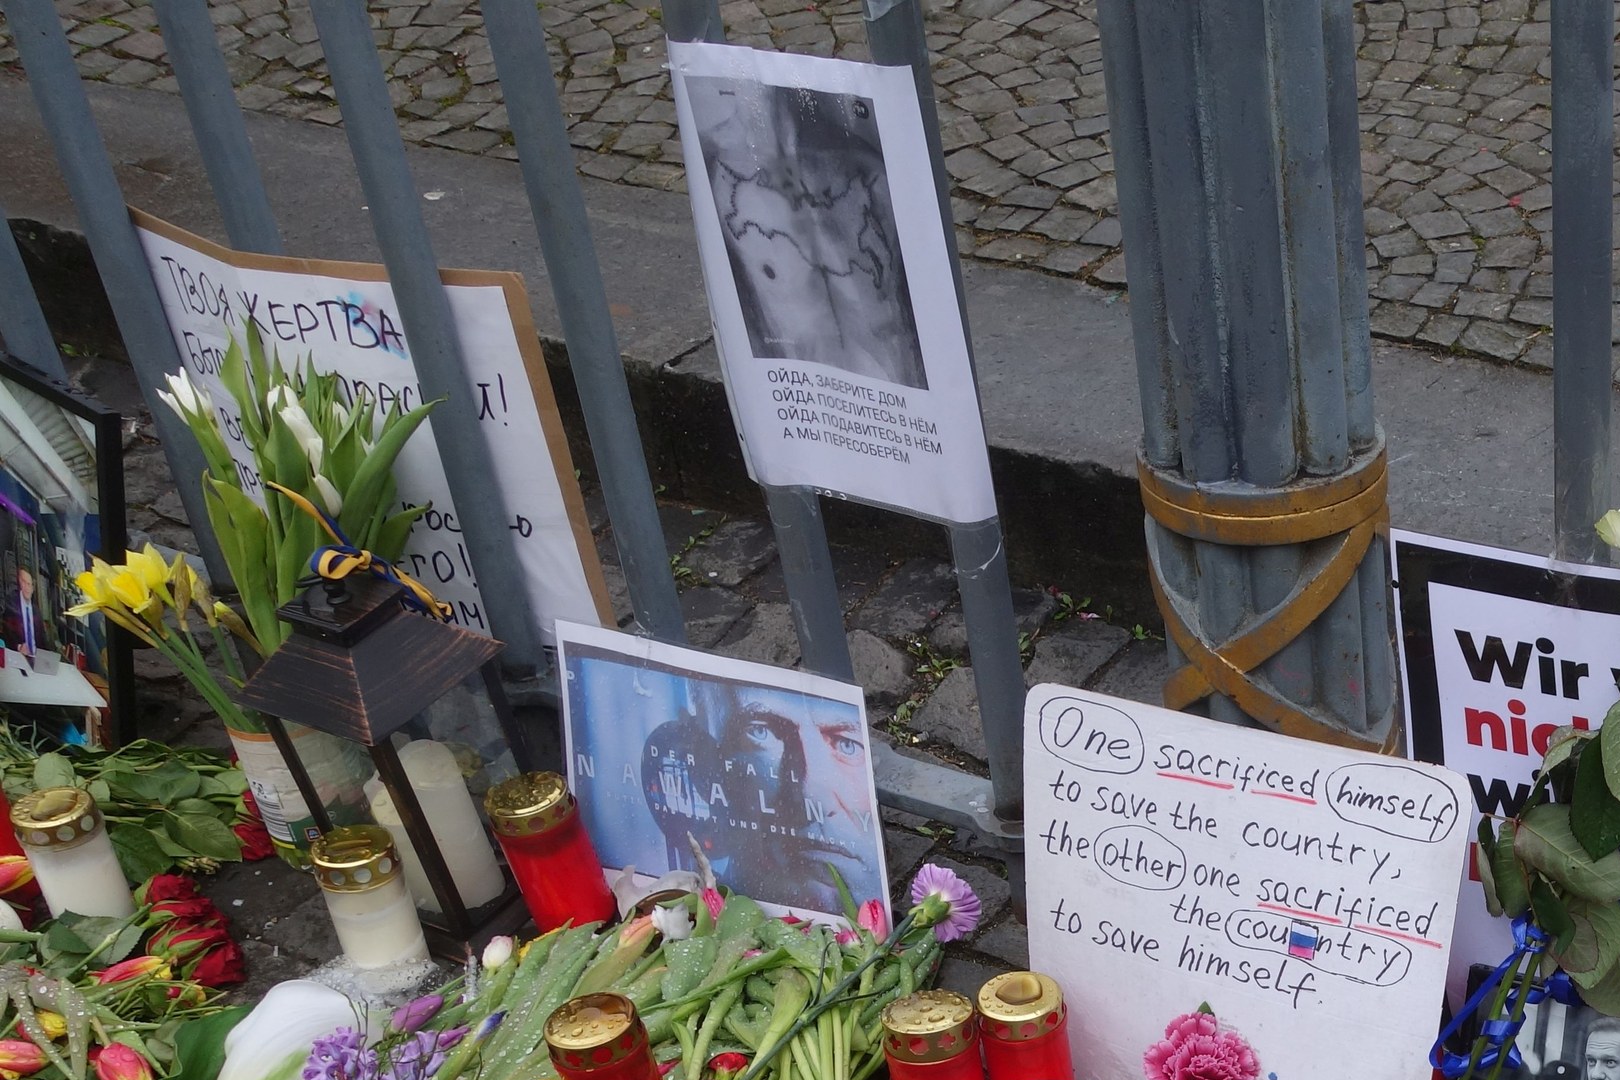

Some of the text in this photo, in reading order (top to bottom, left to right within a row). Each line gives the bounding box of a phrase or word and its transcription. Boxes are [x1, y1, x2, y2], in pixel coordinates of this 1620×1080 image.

[161, 256, 403, 352] ТВОЯ ЖЕРТВА
[767, 368, 907, 409] ОЙДА, ЗАБЕРИТЕ ДОМ
[772, 387, 937, 435] ОЙДА ПОСЕЛИТЕСЬ В НЁМ
[777, 406, 943, 455] ОЙДА ПОДАВИТЕСЬ В НЁМ
[783, 427, 911, 464] А МЫ ПЕРЕСОБЕРЁМ
[1454, 629, 1589, 700] Wir
[650, 745, 799, 783] DER FALL
[1054, 707, 1453, 842] One sacrificed himself
[577, 753, 871, 833] NAWALNY
[729, 818, 758, 830] UND
[770, 825, 796, 837] DIE
[1049, 770, 1402, 884] to save the country,
[1040, 820, 1439, 937] the other one sacrificed
[1051, 899, 1083, 934] to
[1092, 921, 1159, 962] save
[1171, 894, 1222, 932] the
